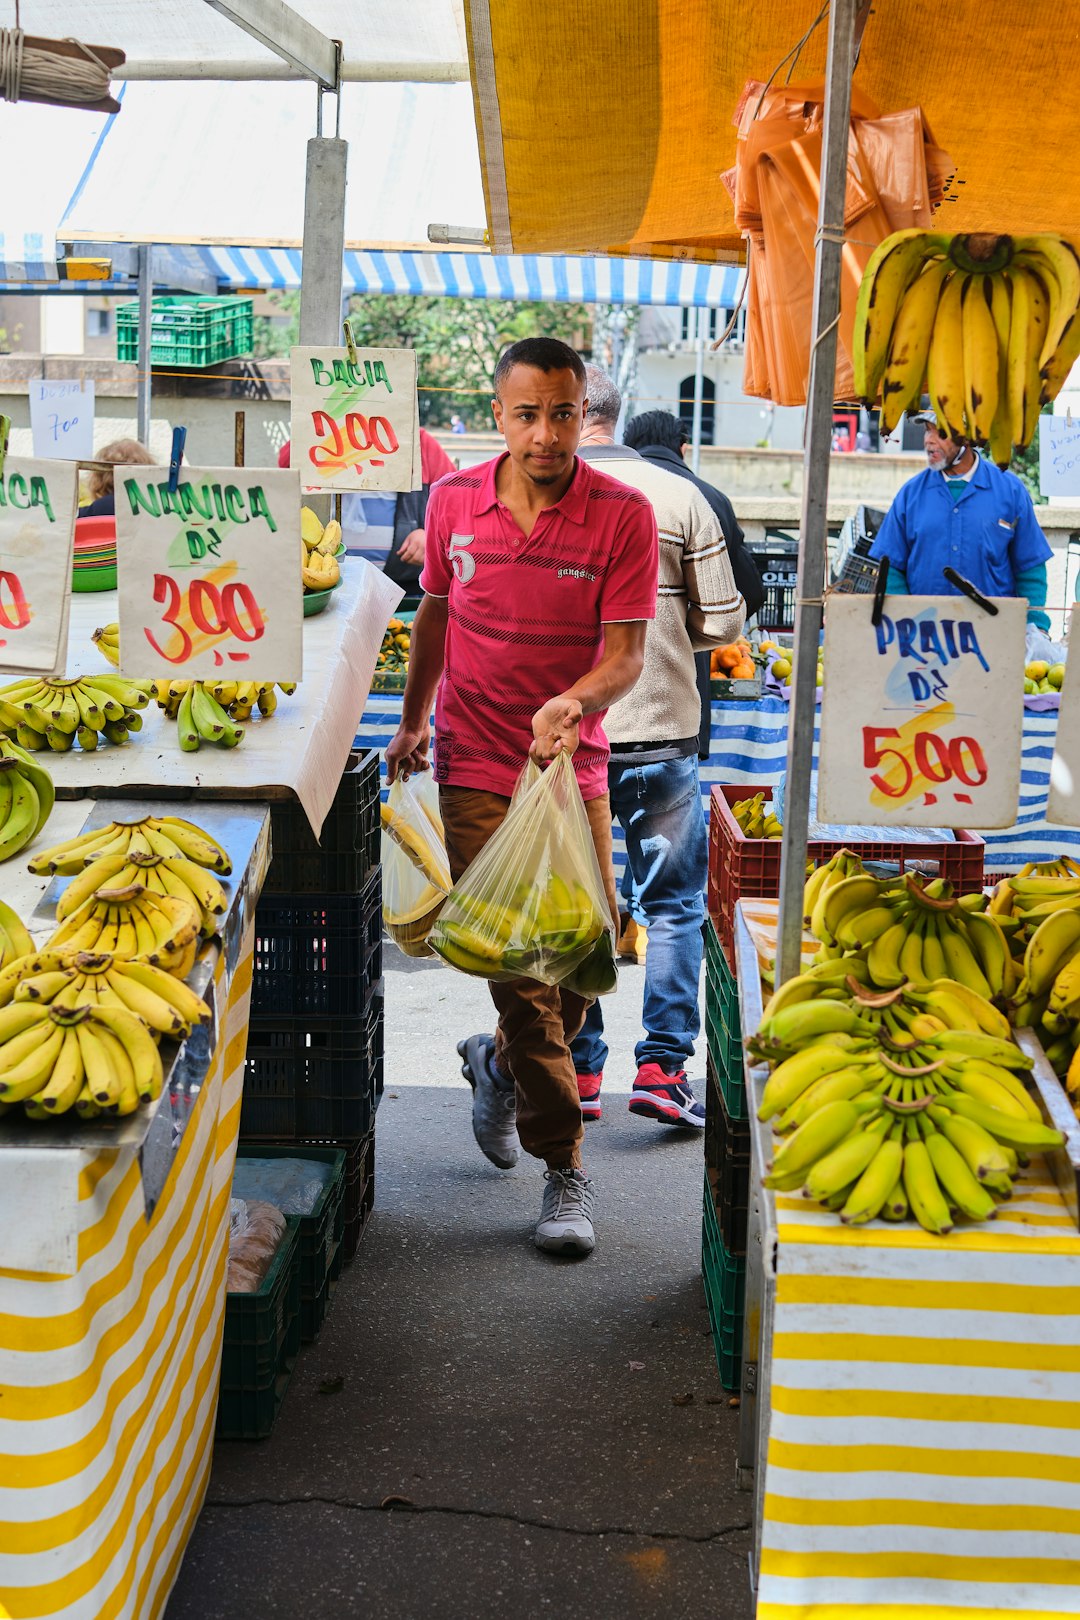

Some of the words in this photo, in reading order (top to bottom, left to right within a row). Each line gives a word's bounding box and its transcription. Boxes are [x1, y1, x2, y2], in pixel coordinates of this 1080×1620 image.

[310, 358, 393, 393] BACIA
[124, 479, 278, 533] NANICA
[449, 532, 476, 584] 5
[557, 568, 596, 582] gangster
[874, 614, 990, 672] PRATA
